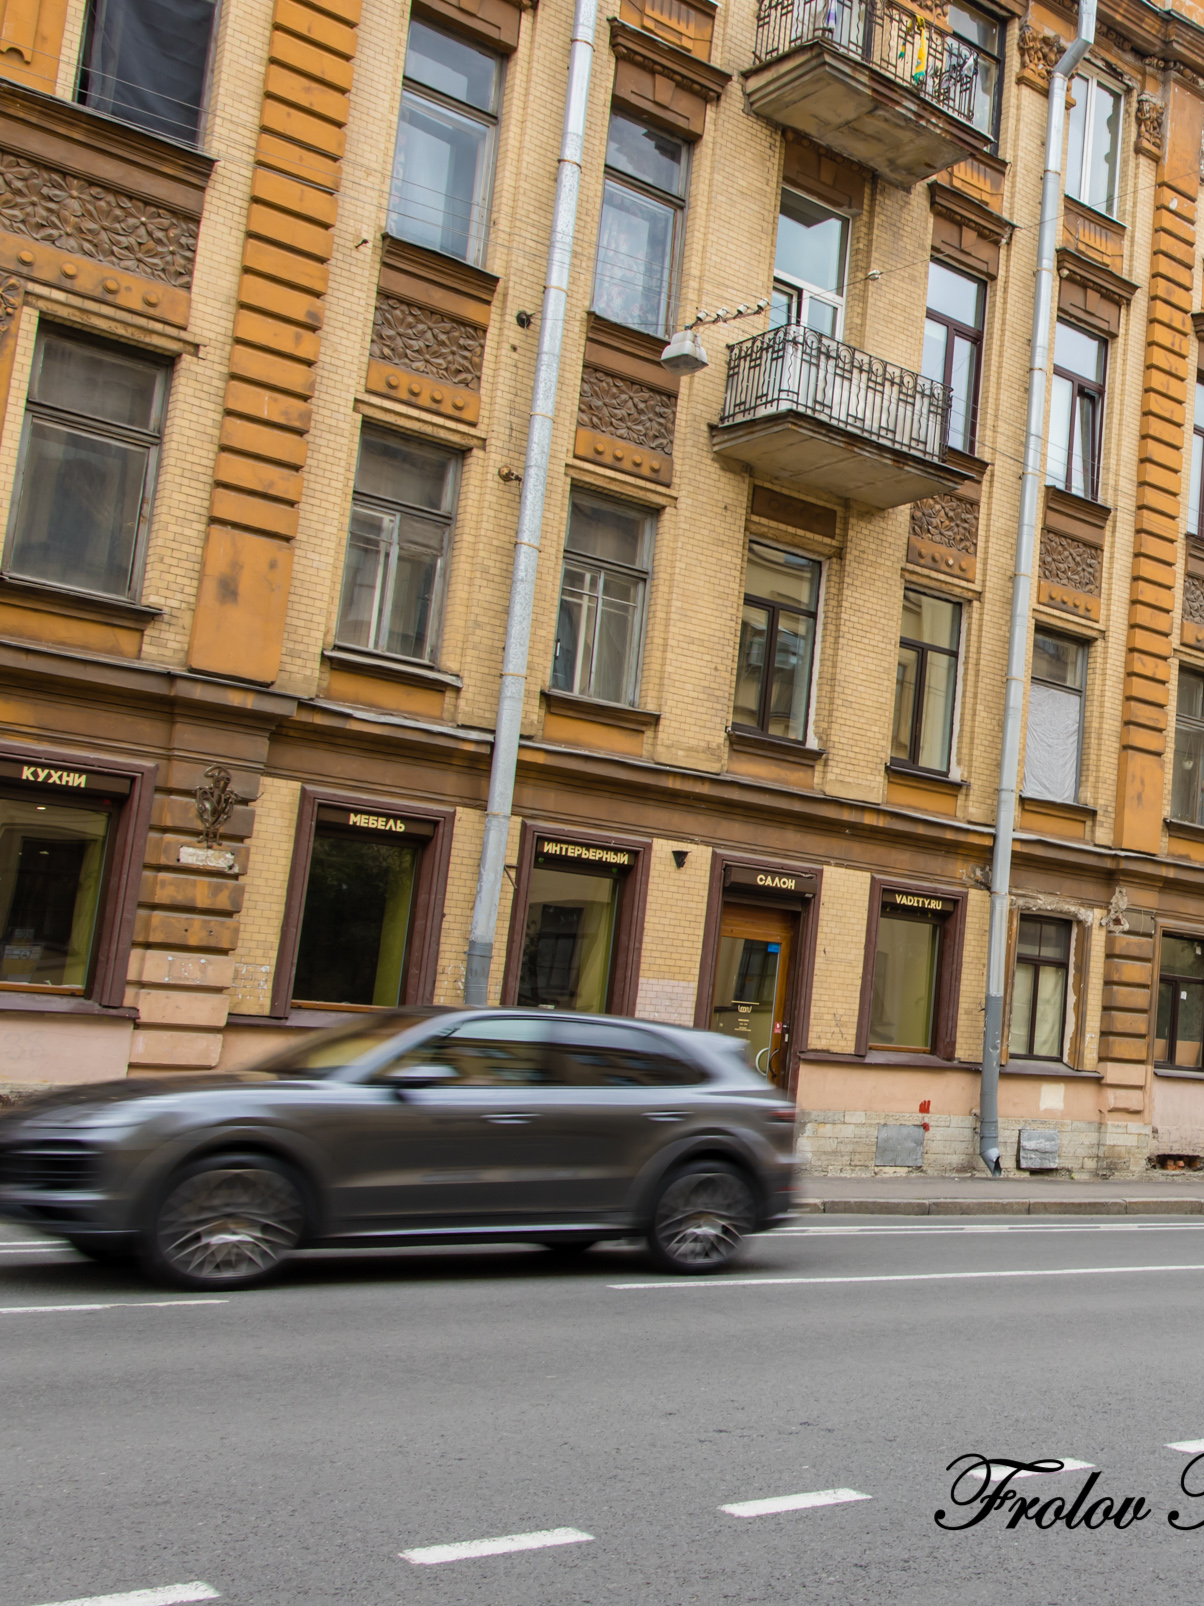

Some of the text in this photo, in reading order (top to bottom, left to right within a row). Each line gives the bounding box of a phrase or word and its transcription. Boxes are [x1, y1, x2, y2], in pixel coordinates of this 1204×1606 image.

[21, 765, 87, 788] КУХНИ
[349, 812, 405, 832] МЕБЕЛЬ
[543, 841, 629, 865] ИНТЕРЬЕРНЫЙ
[756, 874, 796, 890] САЛОН
[895, 893, 942, 910] VADITY.RU
